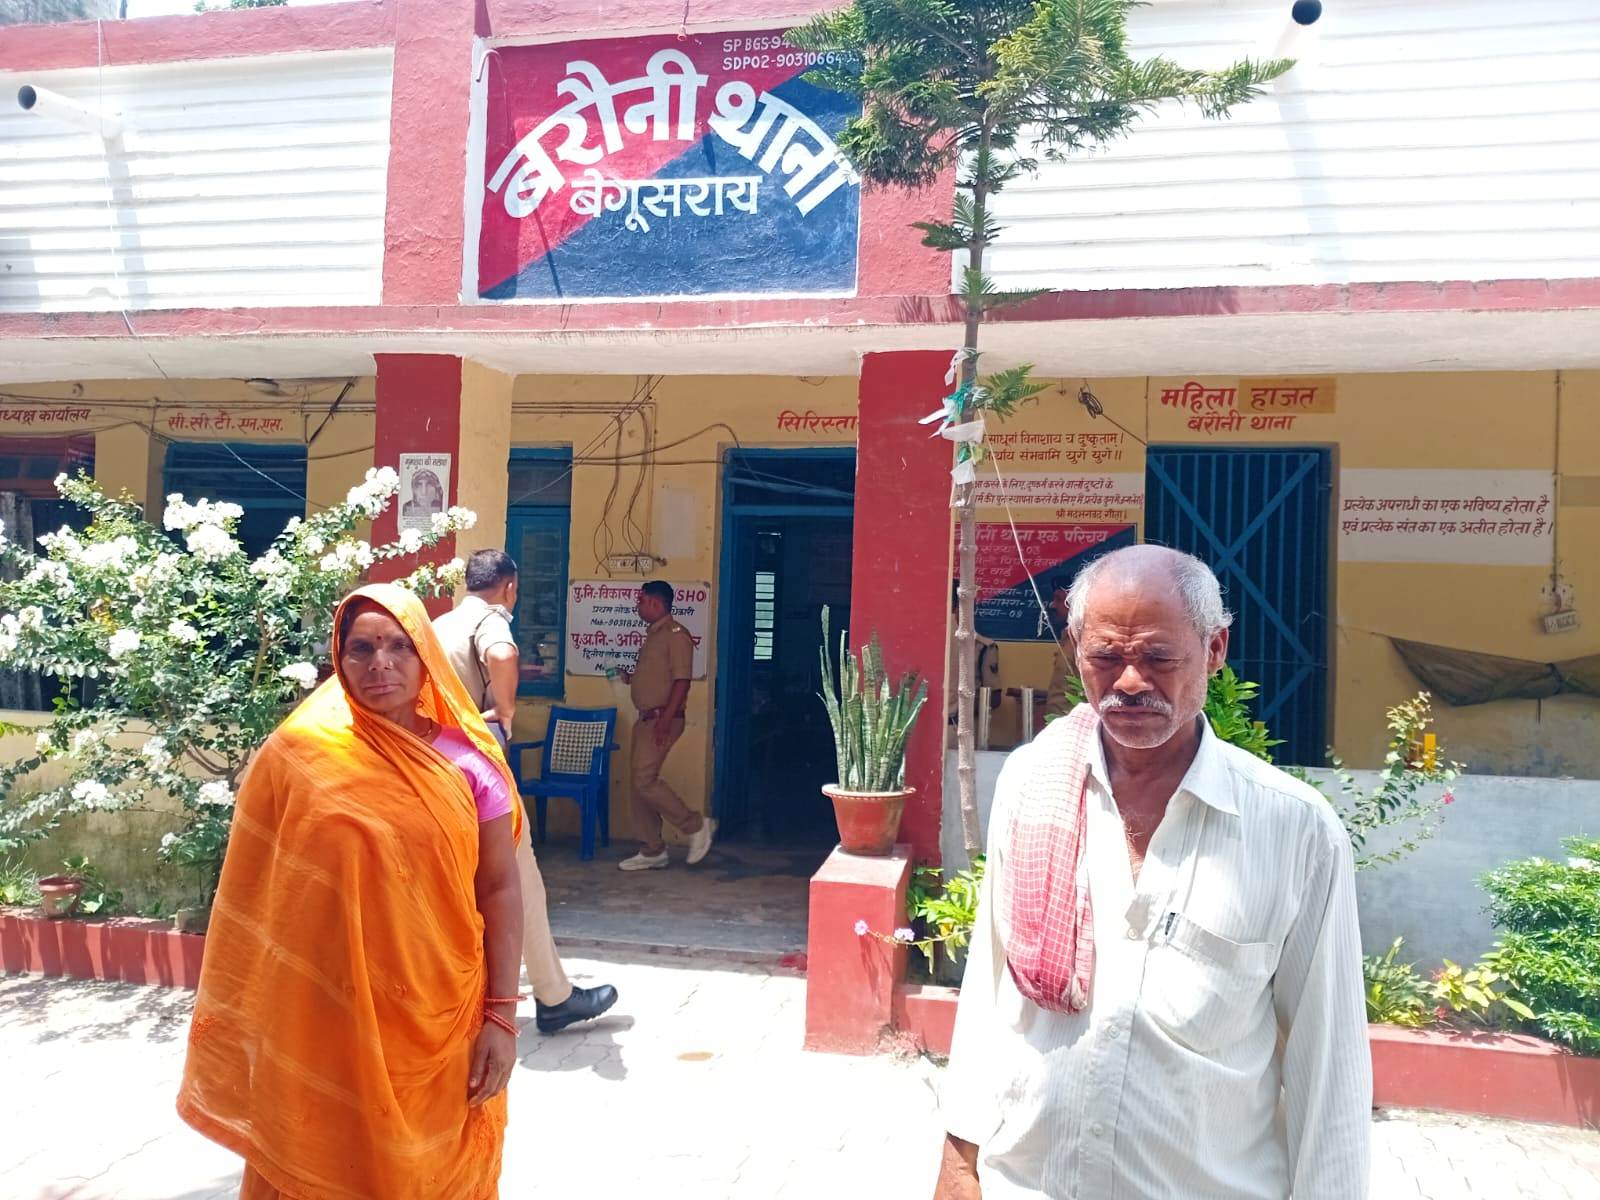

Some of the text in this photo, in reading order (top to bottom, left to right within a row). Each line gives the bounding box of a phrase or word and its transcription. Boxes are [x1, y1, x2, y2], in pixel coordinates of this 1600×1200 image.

[722, 38, 742, 53] SP
[487, 48, 861, 219] बरौनी थाना
[569, 169, 763, 234] बेगूसराय
[1160, 381, 1319, 414] महिला हाजत
[39, 407, 92, 423] कार्यालय
[1249, 415, 1297, 431] थाना
[1066, 434, 1075, 444] च
[1066, 447, 1088, 464] युगे
[1343, 495, 1550, 514] प्रत्येक अपराधी का एक भविष्य होता है
[1037, 529, 1059, 545] एक
[1063, 526, 1109, 544] परिचय
[1342, 518, 1357, 535] एवं
[1359, 517, 1394, 533] प्रत्येक
[1396, 518, 1418, 534] संत
[1418, 521, 1435, 533] का
[1438, 521, 1456, 536] एक
[1459, 519, 1498, 535] अतीत
[1499, 518, 1532, 537] होता
